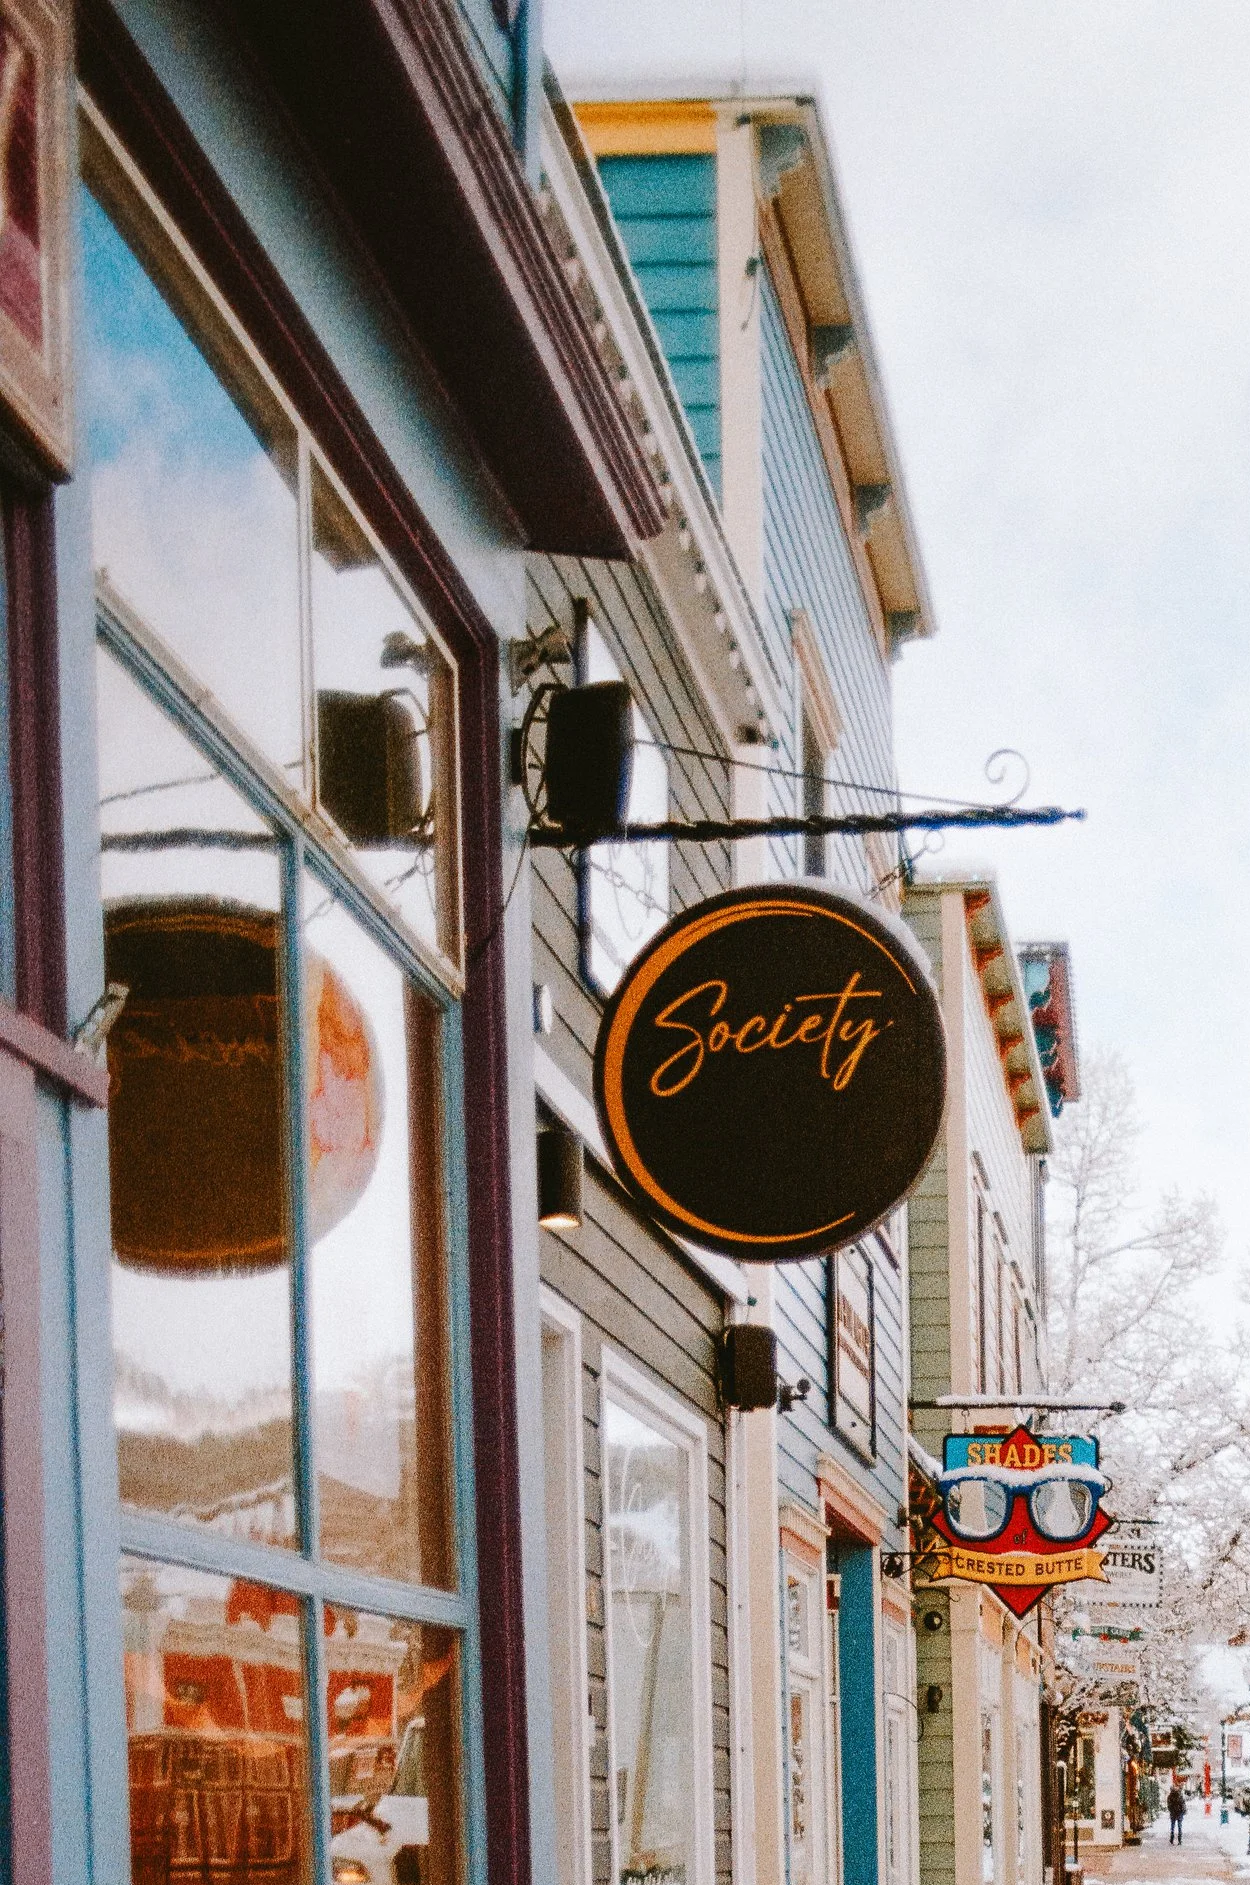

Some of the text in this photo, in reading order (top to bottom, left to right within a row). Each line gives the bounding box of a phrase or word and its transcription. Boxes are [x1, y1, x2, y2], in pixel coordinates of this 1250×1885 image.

[650, 971, 893, 1097] Society
[967, 1442, 1073, 1467] SHADES
[1013, 1529, 1028, 1545] of
[955, 1557, 1025, 1577] CRESTED
[1035, 1558, 1084, 1576] BUTTE
[1103, 1551, 1155, 1575] STERS
